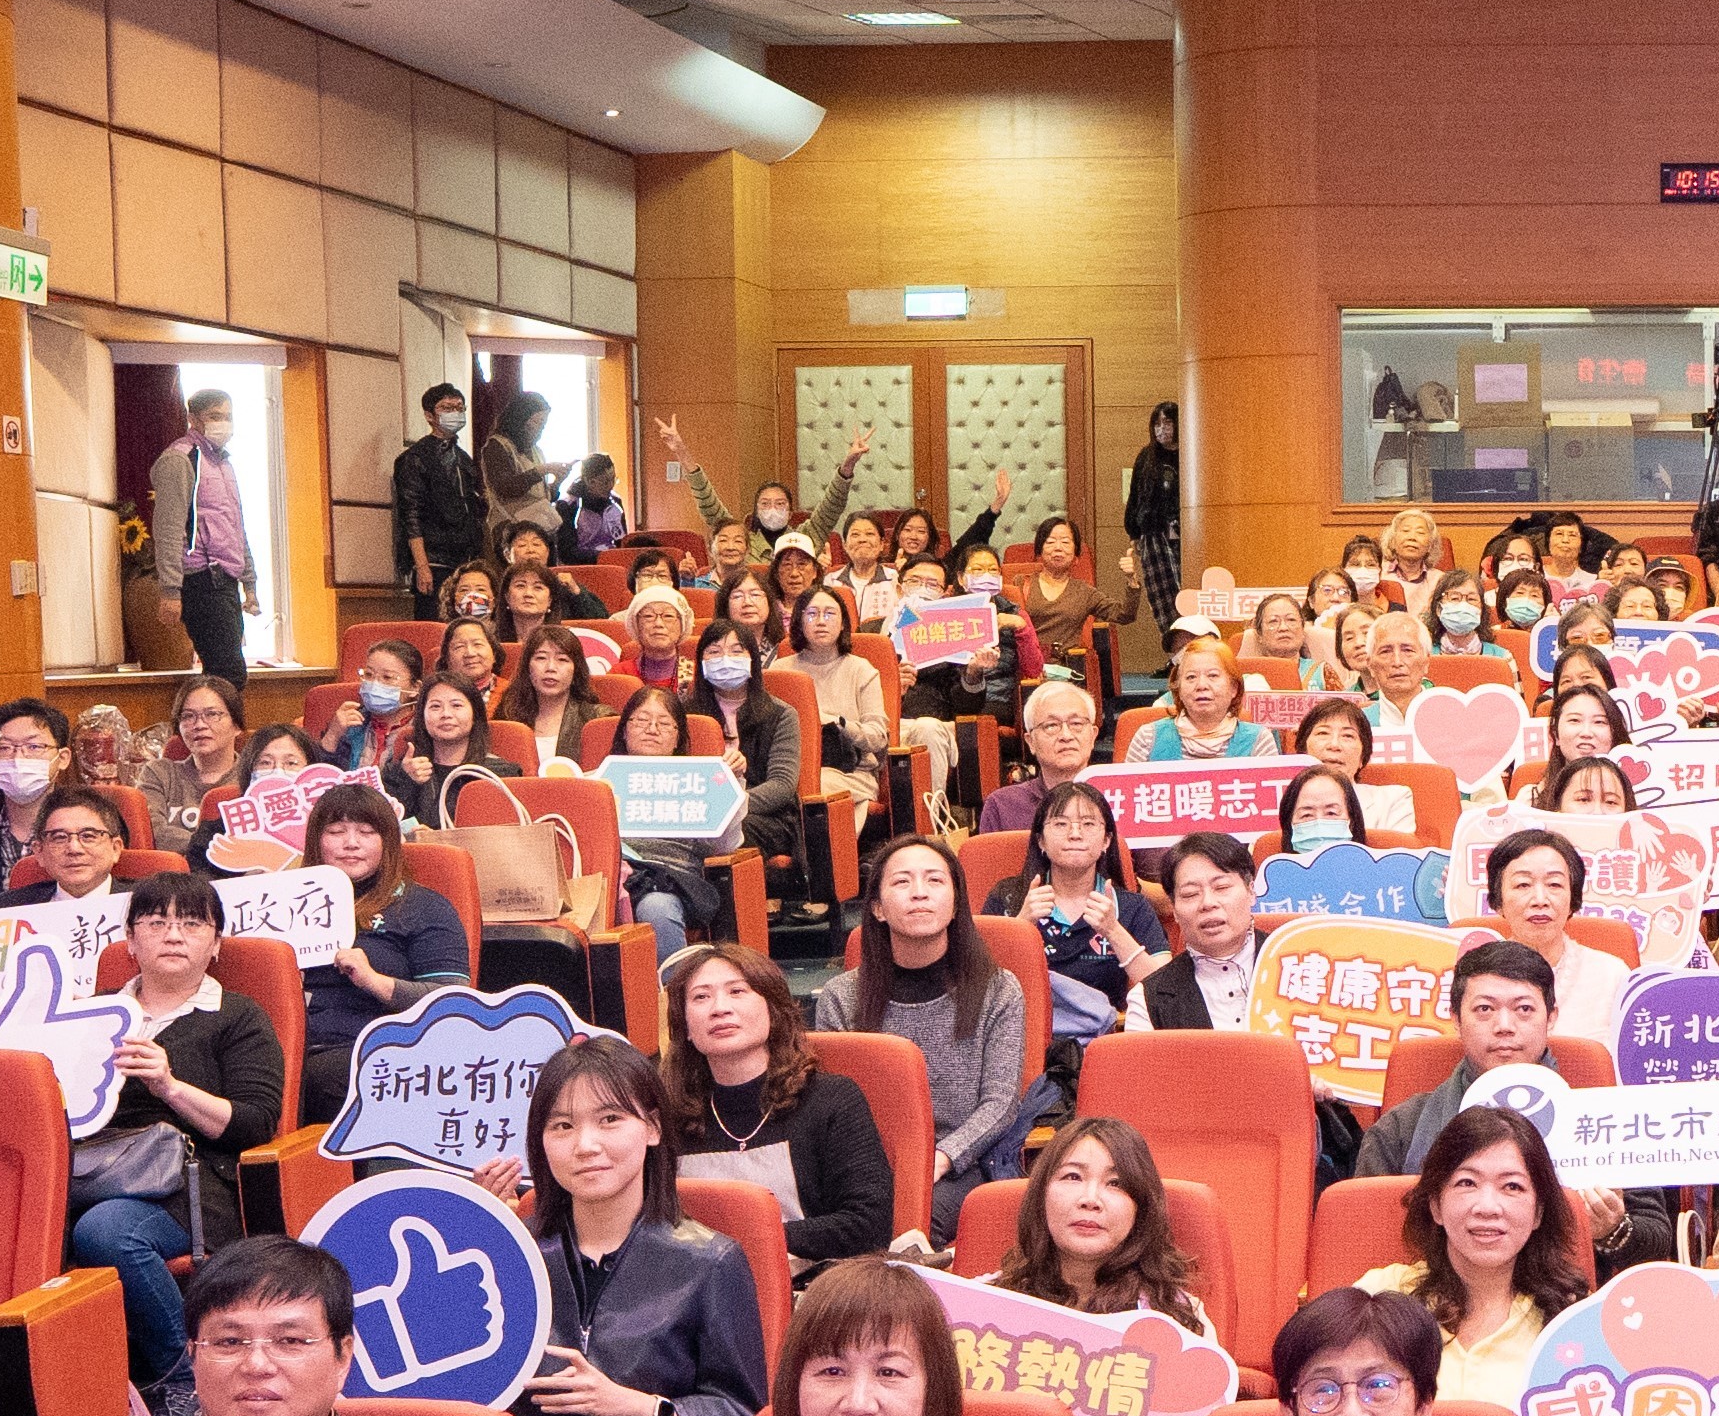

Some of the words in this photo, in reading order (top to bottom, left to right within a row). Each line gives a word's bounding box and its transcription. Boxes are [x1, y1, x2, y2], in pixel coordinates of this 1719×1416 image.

[909, 618, 986, 645] 快樂志工
[627, 771, 707, 795] 我新北
[625, 799, 709, 824] 我驕傲
[1278, 951, 1454, 1021] 健康守
[434, 1107, 517, 1157] 真好
[1595, 1151, 1615, 1166] of
